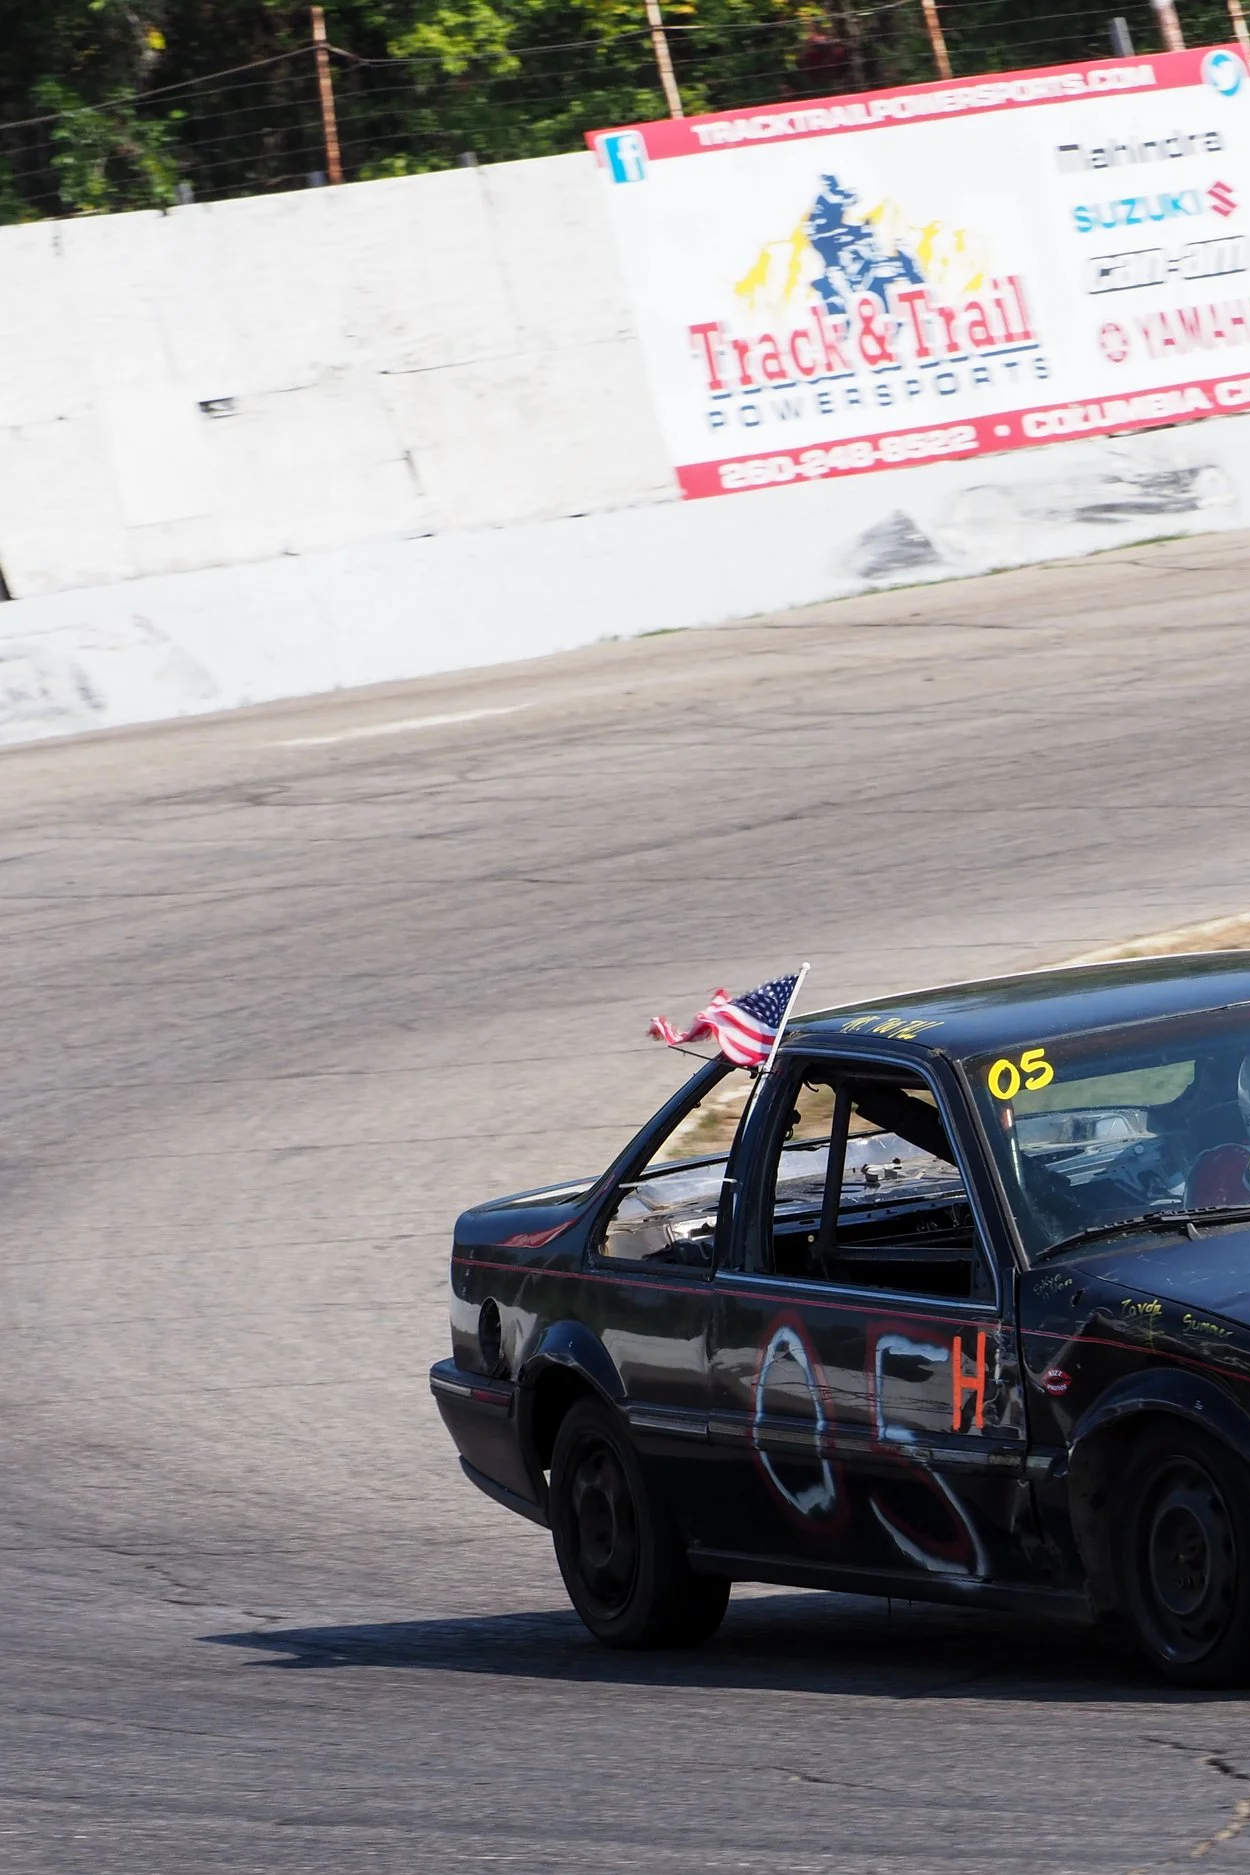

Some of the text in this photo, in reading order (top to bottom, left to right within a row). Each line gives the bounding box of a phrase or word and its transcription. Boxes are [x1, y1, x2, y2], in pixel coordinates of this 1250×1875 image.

[1056, 130, 1225, 174] Mahindra
[1072, 189, 1204, 233] SUZUKI
[706, 357, 1052, 431] POWERSPORTS
[1021, 387, 1214, 437] COLUMBIA
[988, 1048, 1054, 1099] 05
[953, 1331, 986, 1431] H
